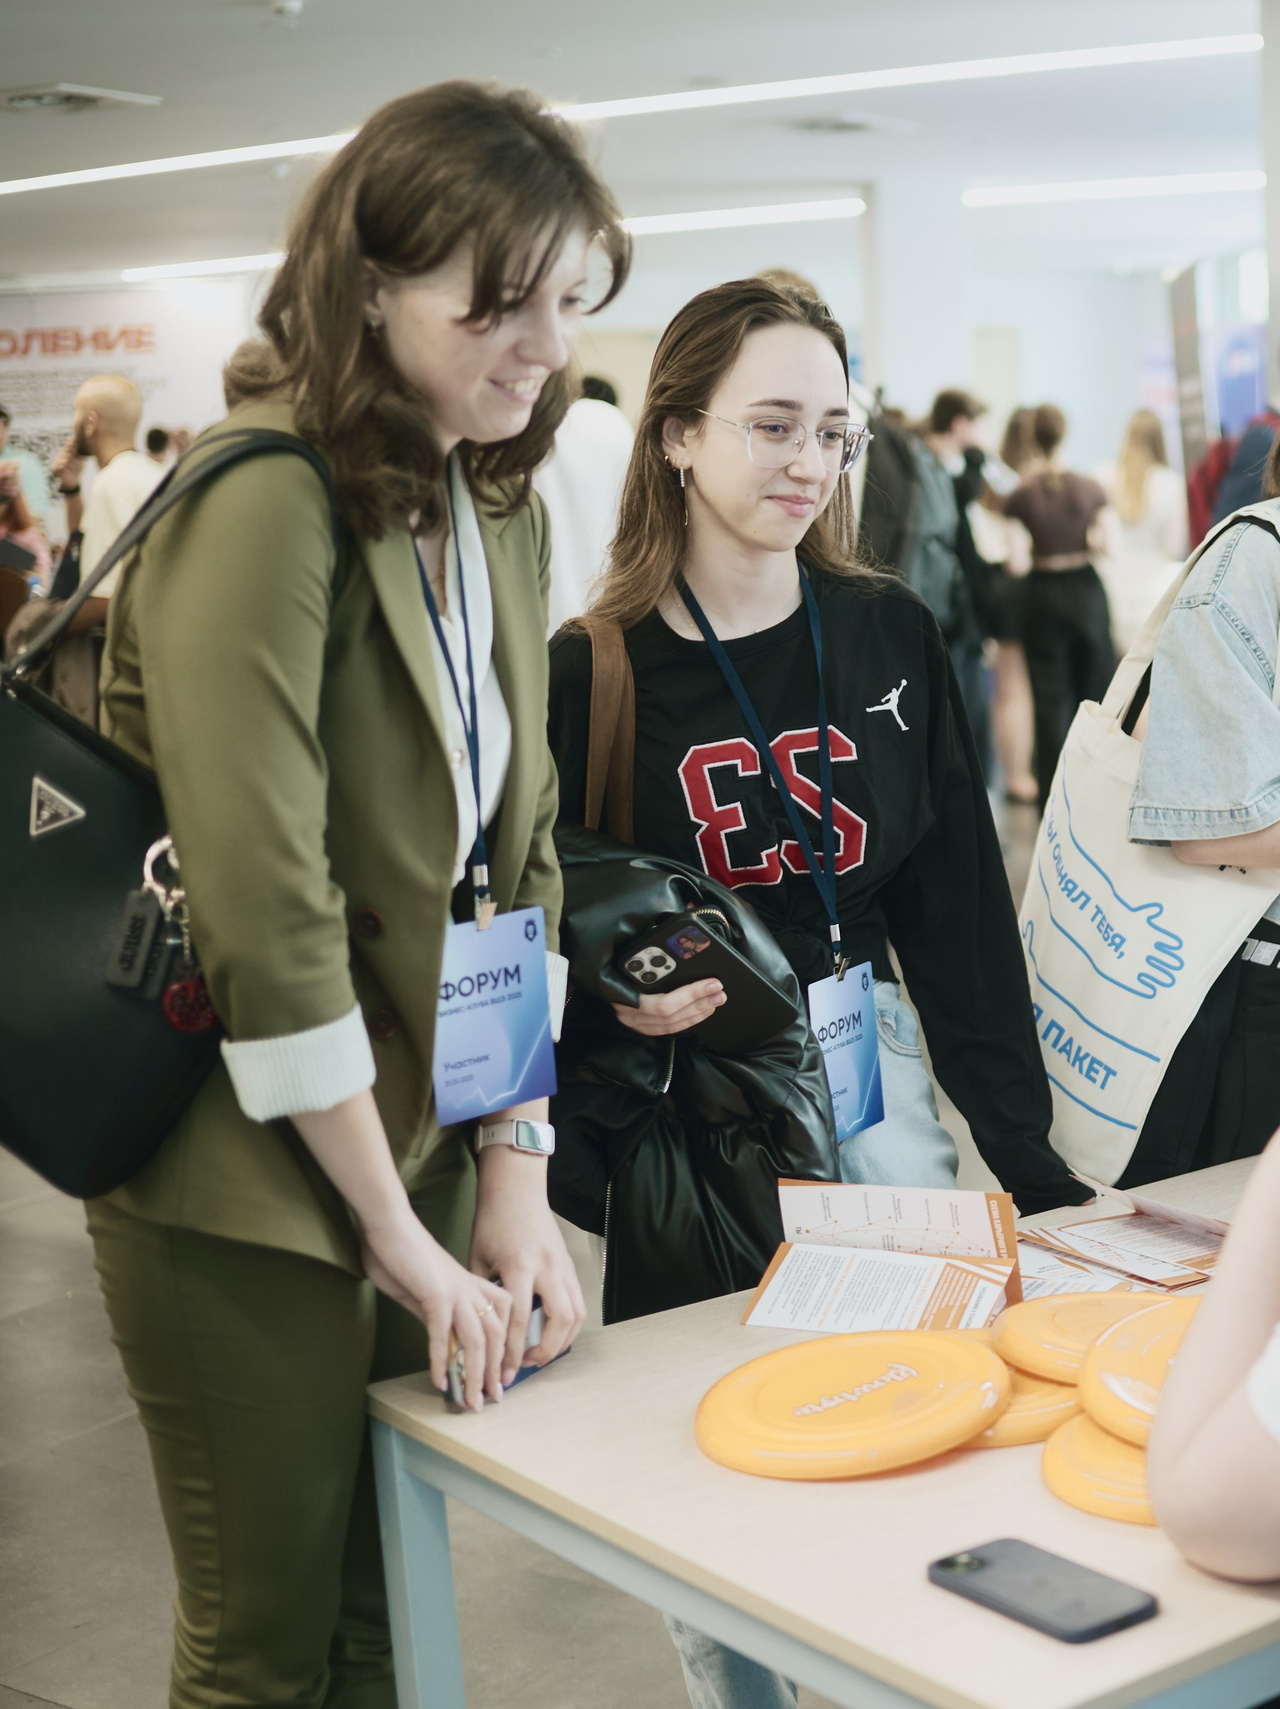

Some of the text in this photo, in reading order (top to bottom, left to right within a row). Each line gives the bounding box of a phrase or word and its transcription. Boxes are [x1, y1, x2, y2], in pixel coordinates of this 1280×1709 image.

[1090, 904, 1127, 960] ТЕБЯ,
[439, 963, 522, 1002] ФОРУМ
[818, 1009, 862, 1044] ФОРУМ
[1041, 1018, 1118, 1090] ПАКЕТ
